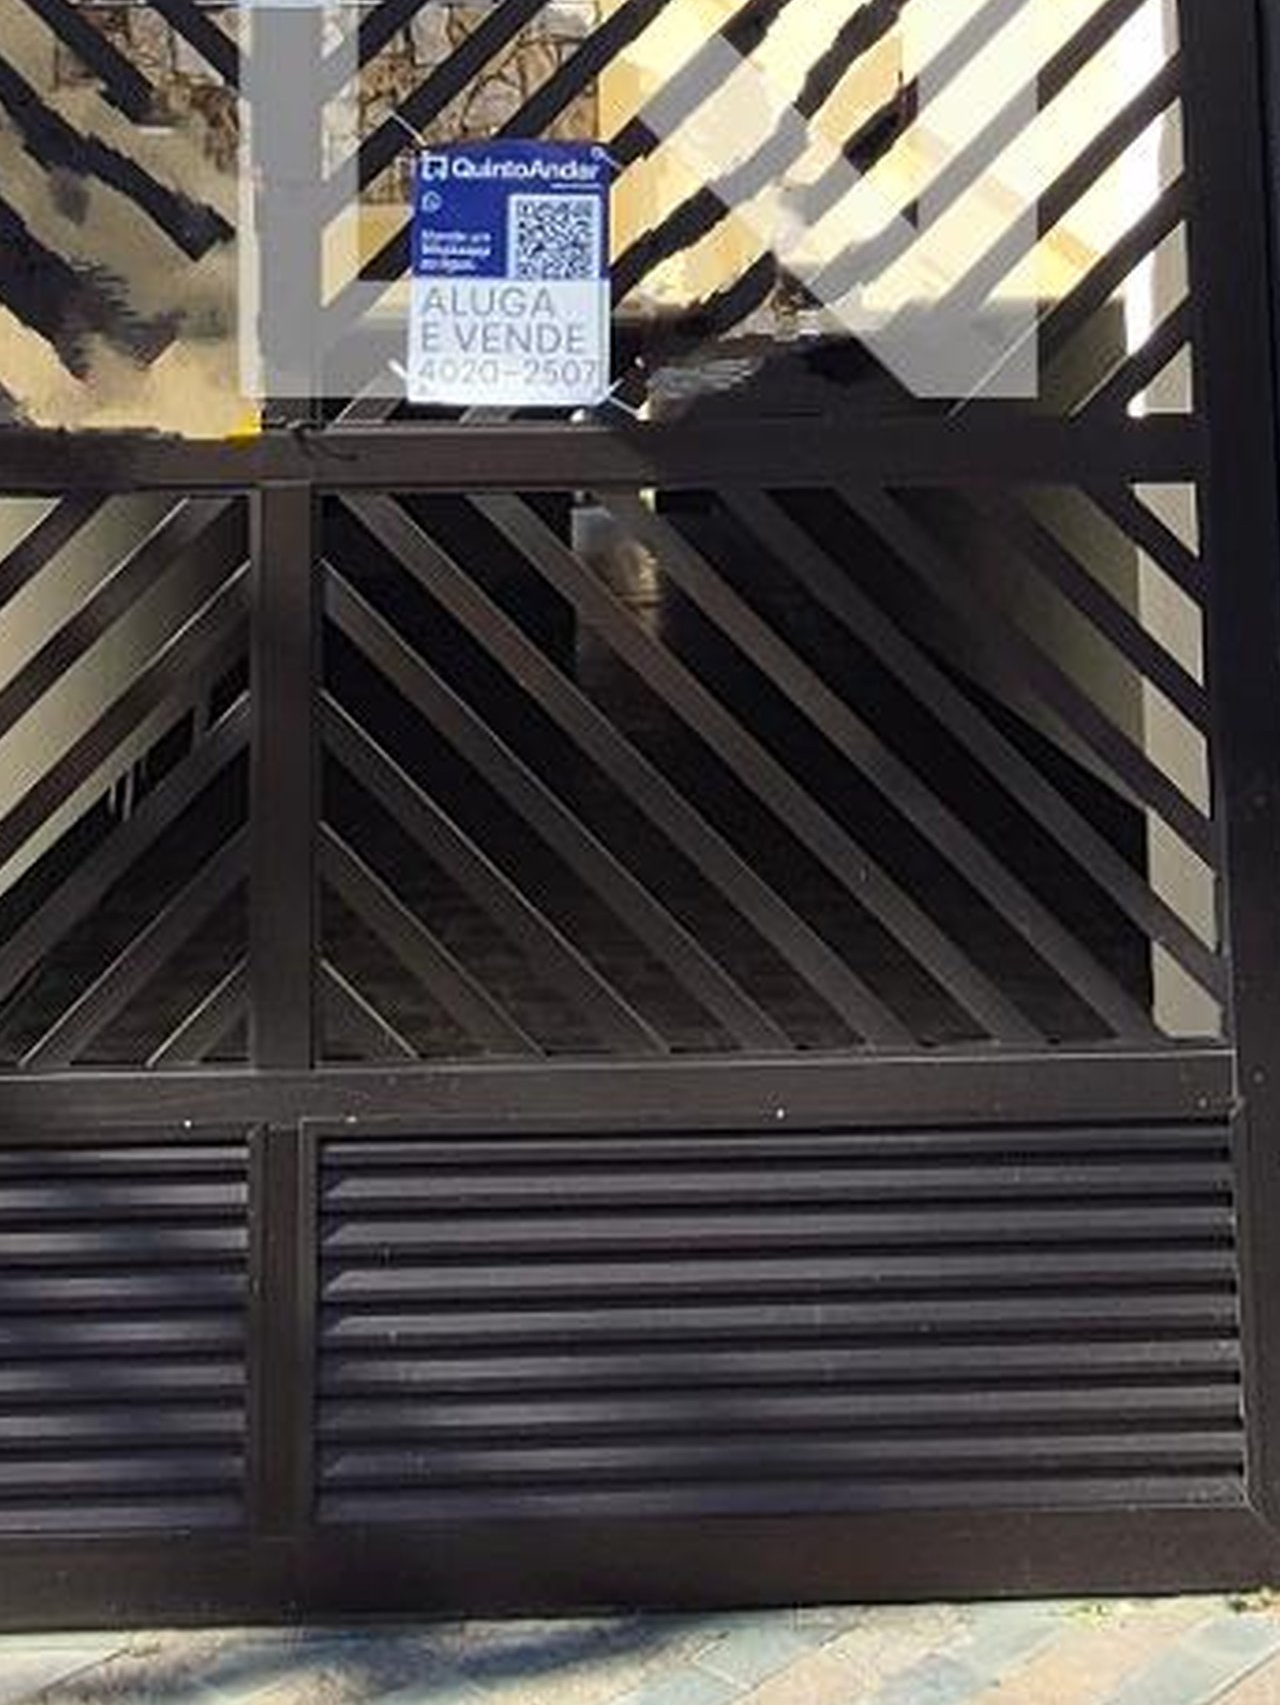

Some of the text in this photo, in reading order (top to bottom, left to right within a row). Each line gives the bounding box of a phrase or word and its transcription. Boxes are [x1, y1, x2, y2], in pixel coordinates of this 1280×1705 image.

[452, 156, 600, 181] QuintoAndar
[422, 286, 555, 318] ALUGA
[422, 322, 587, 354] E VENDE
[418, 358, 598, 386] 4020-2507
